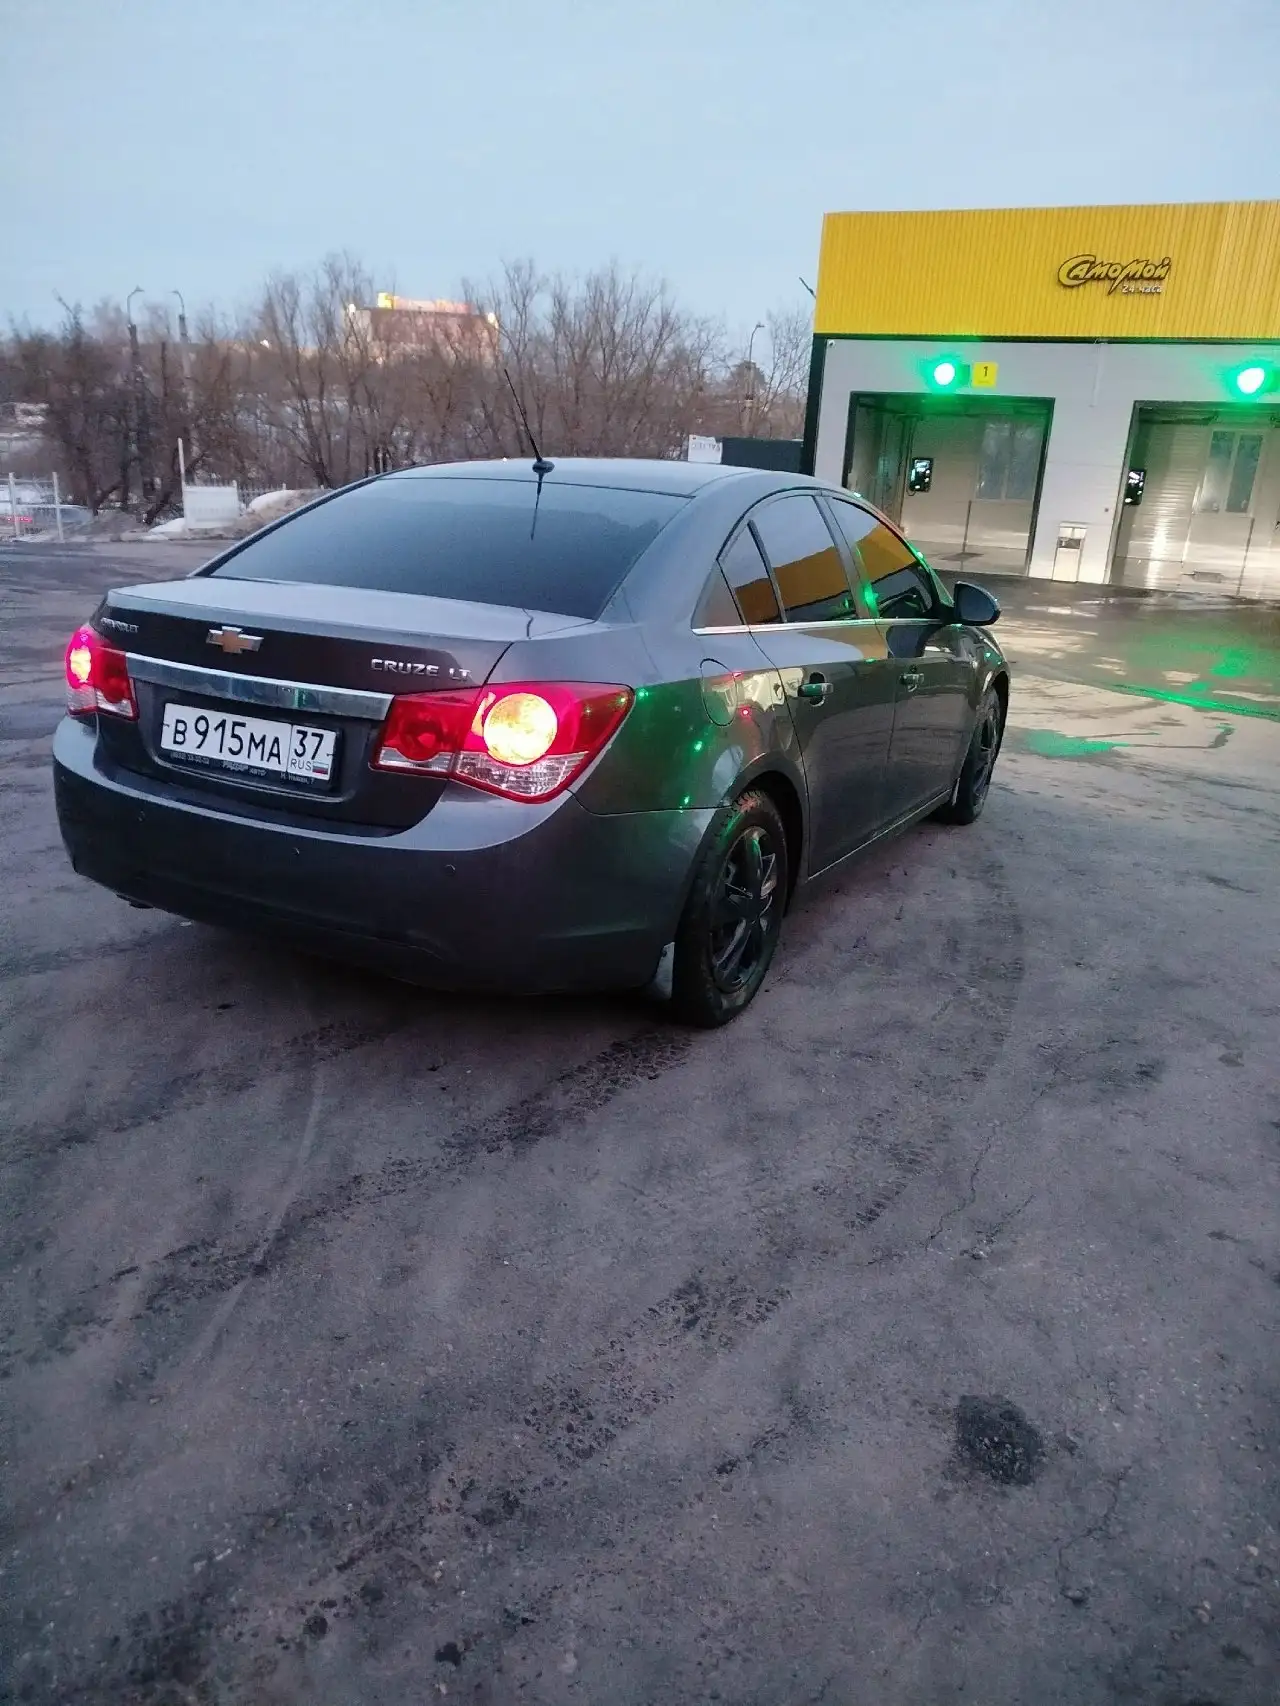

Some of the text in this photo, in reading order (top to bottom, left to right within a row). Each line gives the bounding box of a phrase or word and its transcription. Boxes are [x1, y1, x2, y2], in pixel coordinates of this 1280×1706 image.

[1121, 284, 1135, 293] 24
[983, 365, 989, 377] 1
[371, 658, 472, 681] CRUZE LT
[293, 729, 324, 760] 37
[290, 758, 312, 771] RUS
